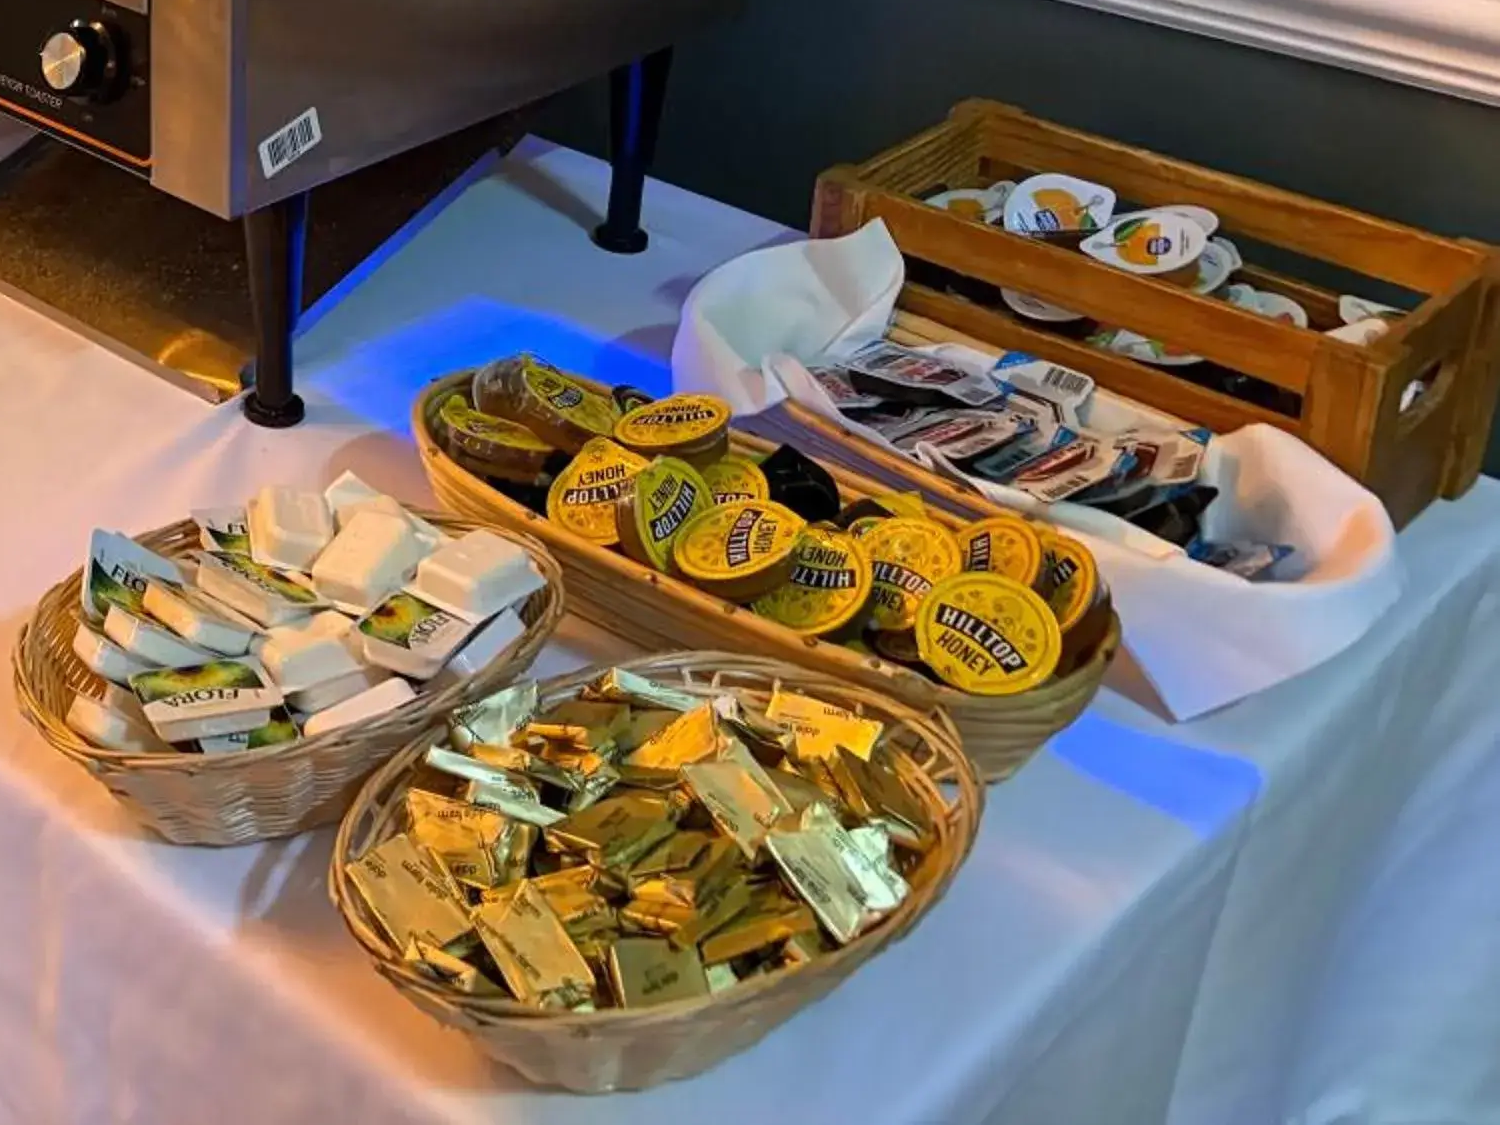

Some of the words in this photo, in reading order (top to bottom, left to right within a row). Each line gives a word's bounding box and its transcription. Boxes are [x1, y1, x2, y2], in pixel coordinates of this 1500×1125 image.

[25, 83, 63, 110] TOASTER
[579, 463, 626, 487] HONEY
[653, 482, 695, 540] HILLTOP
[727, 510, 757, 565] HILLTOP
[110, 563, 148, 593] FLO
[935, 630, 995, 676] HONEY
[940, 606, 1023, 669] HILLTOP
[161, 687, 239, 708] FLORA
